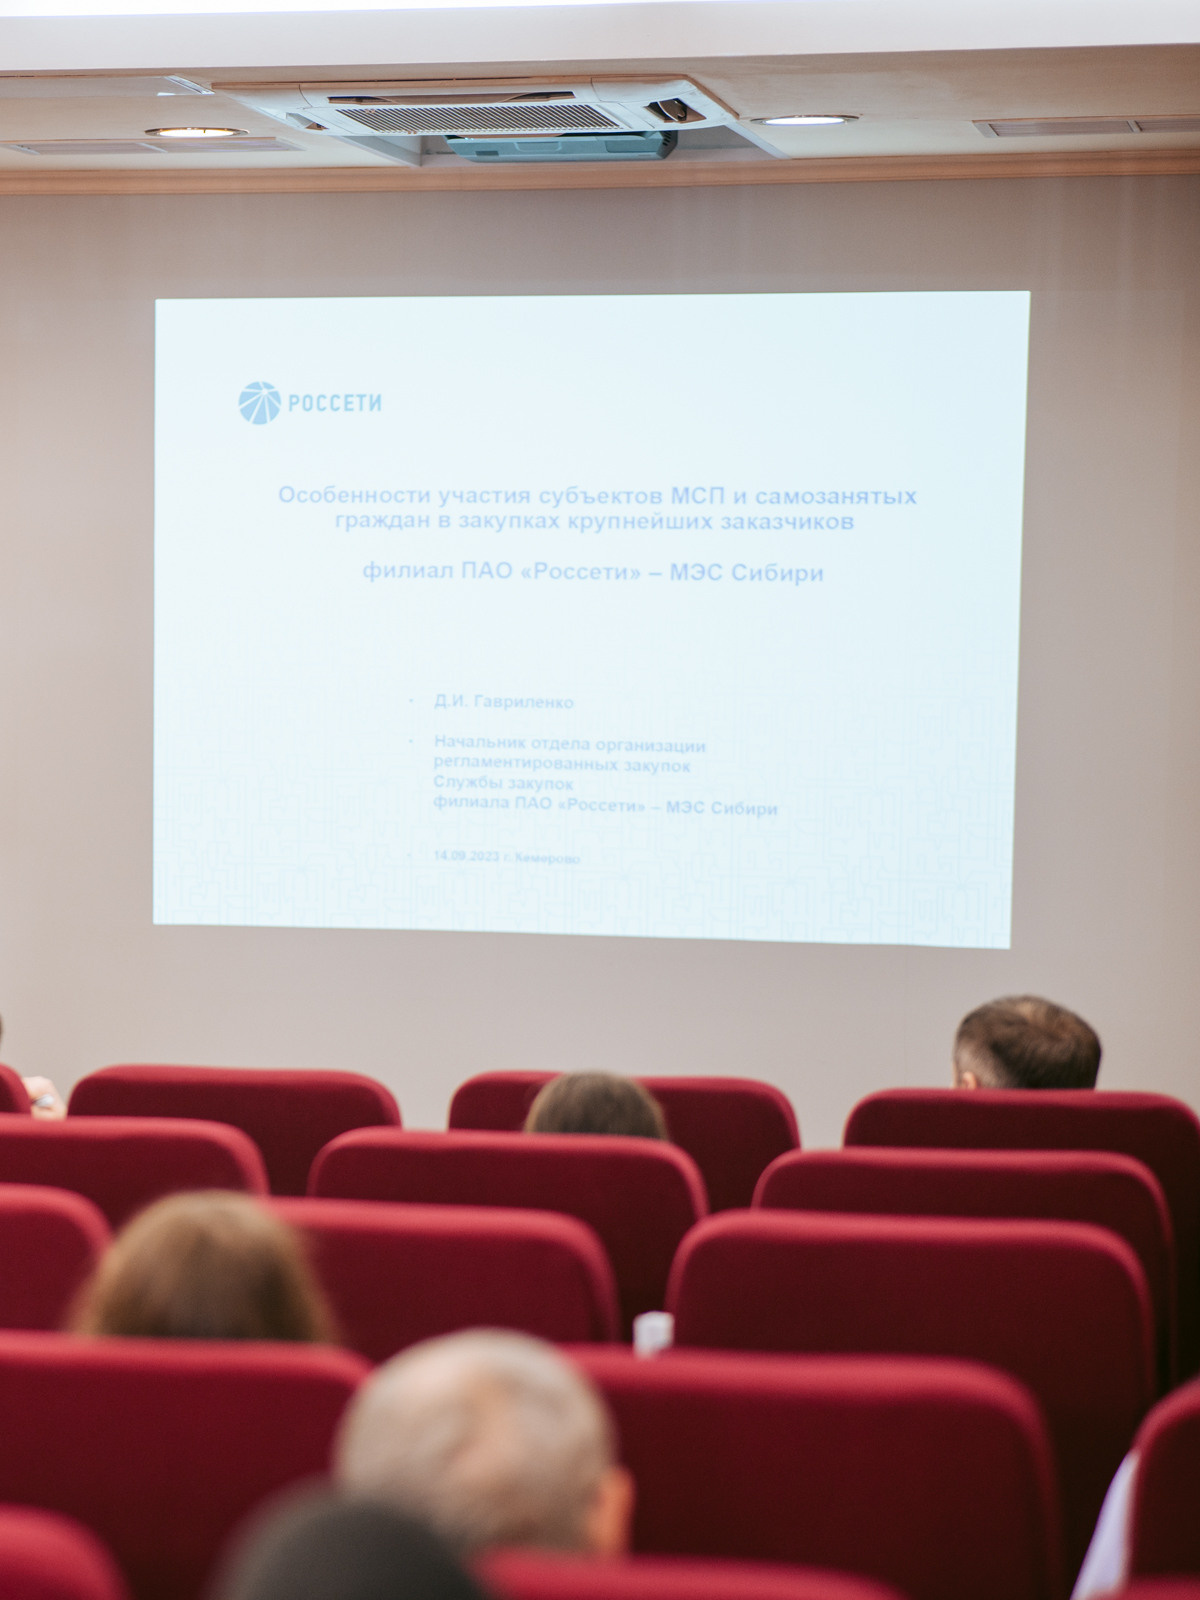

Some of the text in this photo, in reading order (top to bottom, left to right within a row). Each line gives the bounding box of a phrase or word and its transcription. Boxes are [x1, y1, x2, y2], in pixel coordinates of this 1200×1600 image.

[288, 393, 382, 412] РОССЕТИ
[278, 485, 917, 509] Особенности участия субъектов МСП и самозанятых
[335, 511, 853, 534] граждан в закупках крупнейших заказчиков
[362, 560, 454, 583] филиал
[461, 561, 513, 580] ПАО
[520, 562, 641, 581] «Россети»
[670, 563, 723, 582] МЭС
[731, 563, 823, 586] Сибири
[434, 694, 574, 711] Д.И. Гавриленко
[434, 734, 706, 754] Начальник отдела организации
[433, 756, 690, 775] регламентированных закупок
[433, 774, 574, 792] Службы закупок
[433, 795, 510, 811] филиала
[514, 796, 552, 810] ПАО
[558, 797, 645, 813] «Россети»
[666, 800, 706, 814] МЭС
[711, 801, 778, 818] Сибири
